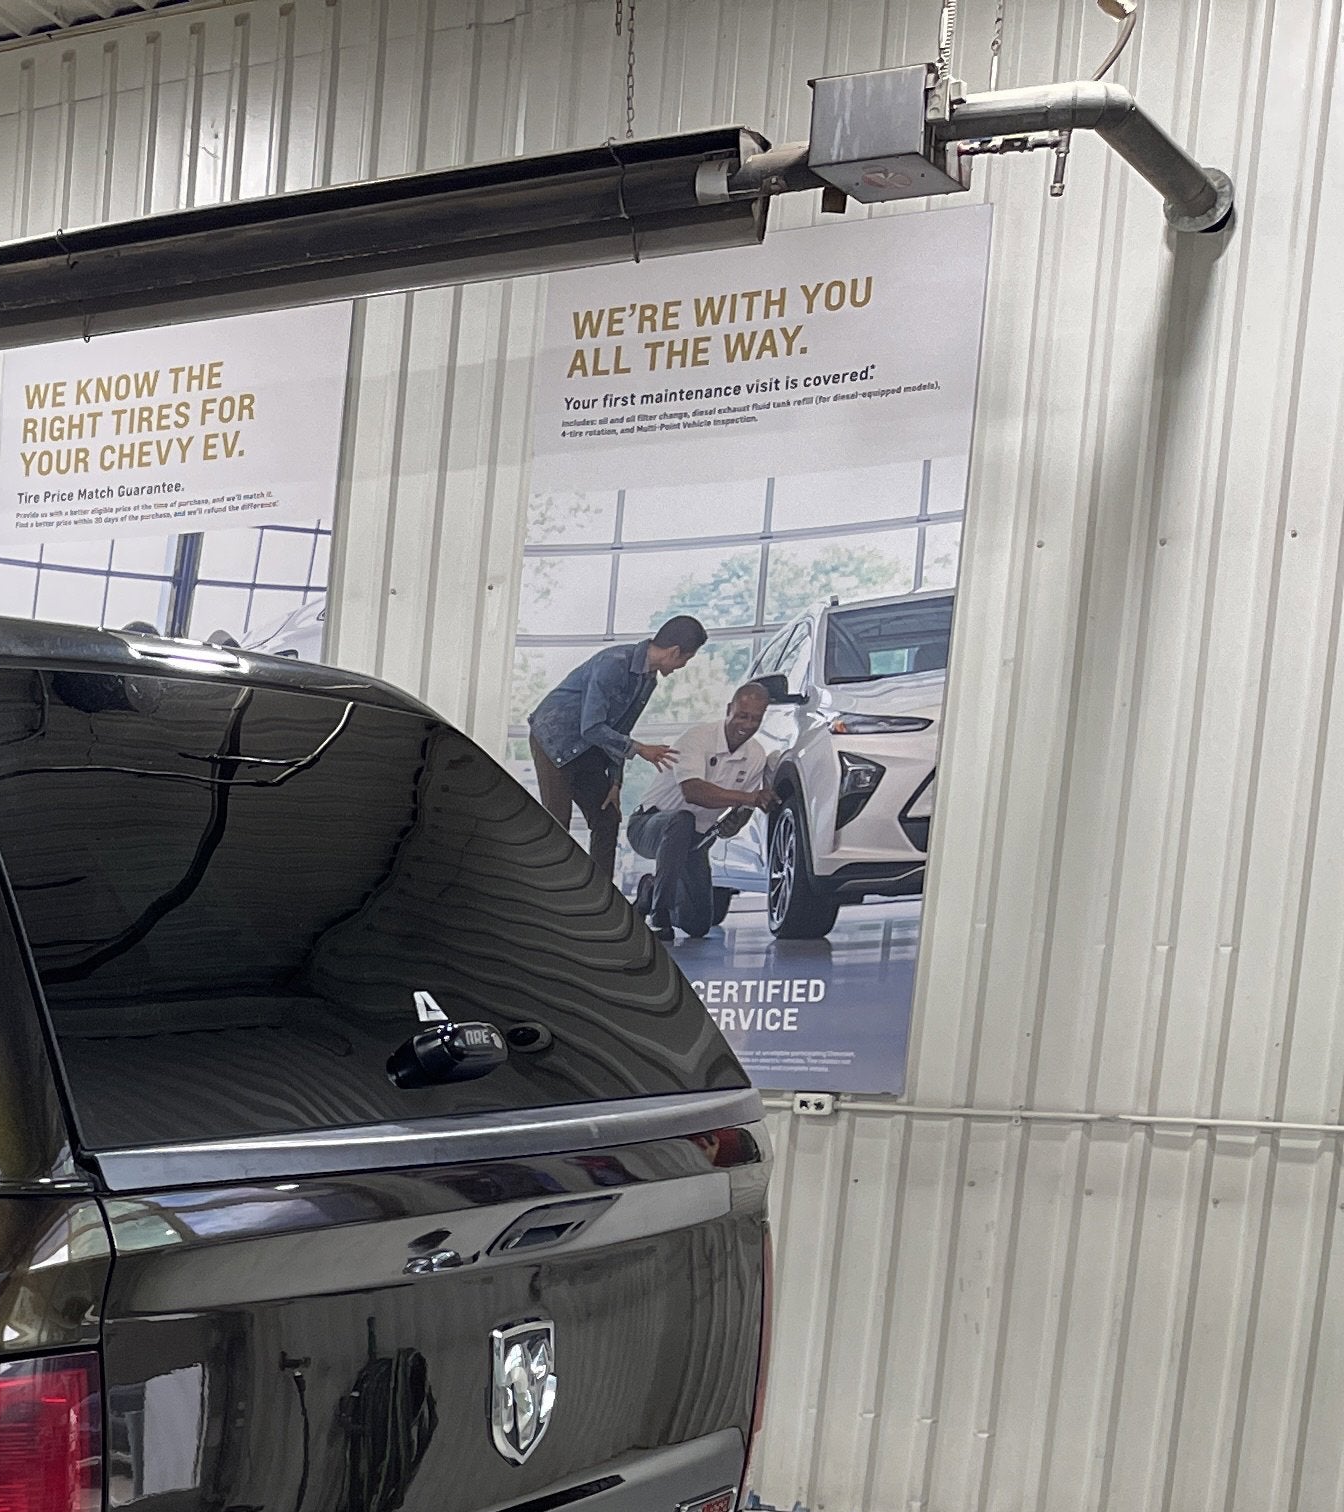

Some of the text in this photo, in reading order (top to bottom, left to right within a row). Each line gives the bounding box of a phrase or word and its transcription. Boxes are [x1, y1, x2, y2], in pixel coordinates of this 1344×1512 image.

[573, 276, 873, 340] WE'RE WITH YOU
[567, 324, 808, 379] ALL THE WAY.
[24, 361, 224, 410] WE KNOW THE
[564, 396, 598, 410] Your
[602, 393, 637, 408] first
[640, 383, 742, 406] maintenance
[746, 377, 780, 395] visit
[785, 375, 799, 390] is
[22, 393, 255, 444] RIGHT TIRES FOR
[610, 415, 625, 424] and
[691, 407, 716, 417] diesel
[717, 404, 750, 415] exhaust
[752, 402, 771, 411] fluid
[773, 399, 791, 409] tank
[815, 394, 831, 405] (for
[620, 425, 634, 435] and
[682, 418, 711, 430] Vehicle
[20, 430, 245, 477] YOUR CHEVY EV.
[17, 481, 184, 505] Tire Price Match Guarantee.
[691, 979, 825, 1003] CERTIFIED
[707, 1007, 799, 1031] ERVICE
[465, 1029, 491, 1046] ARE
